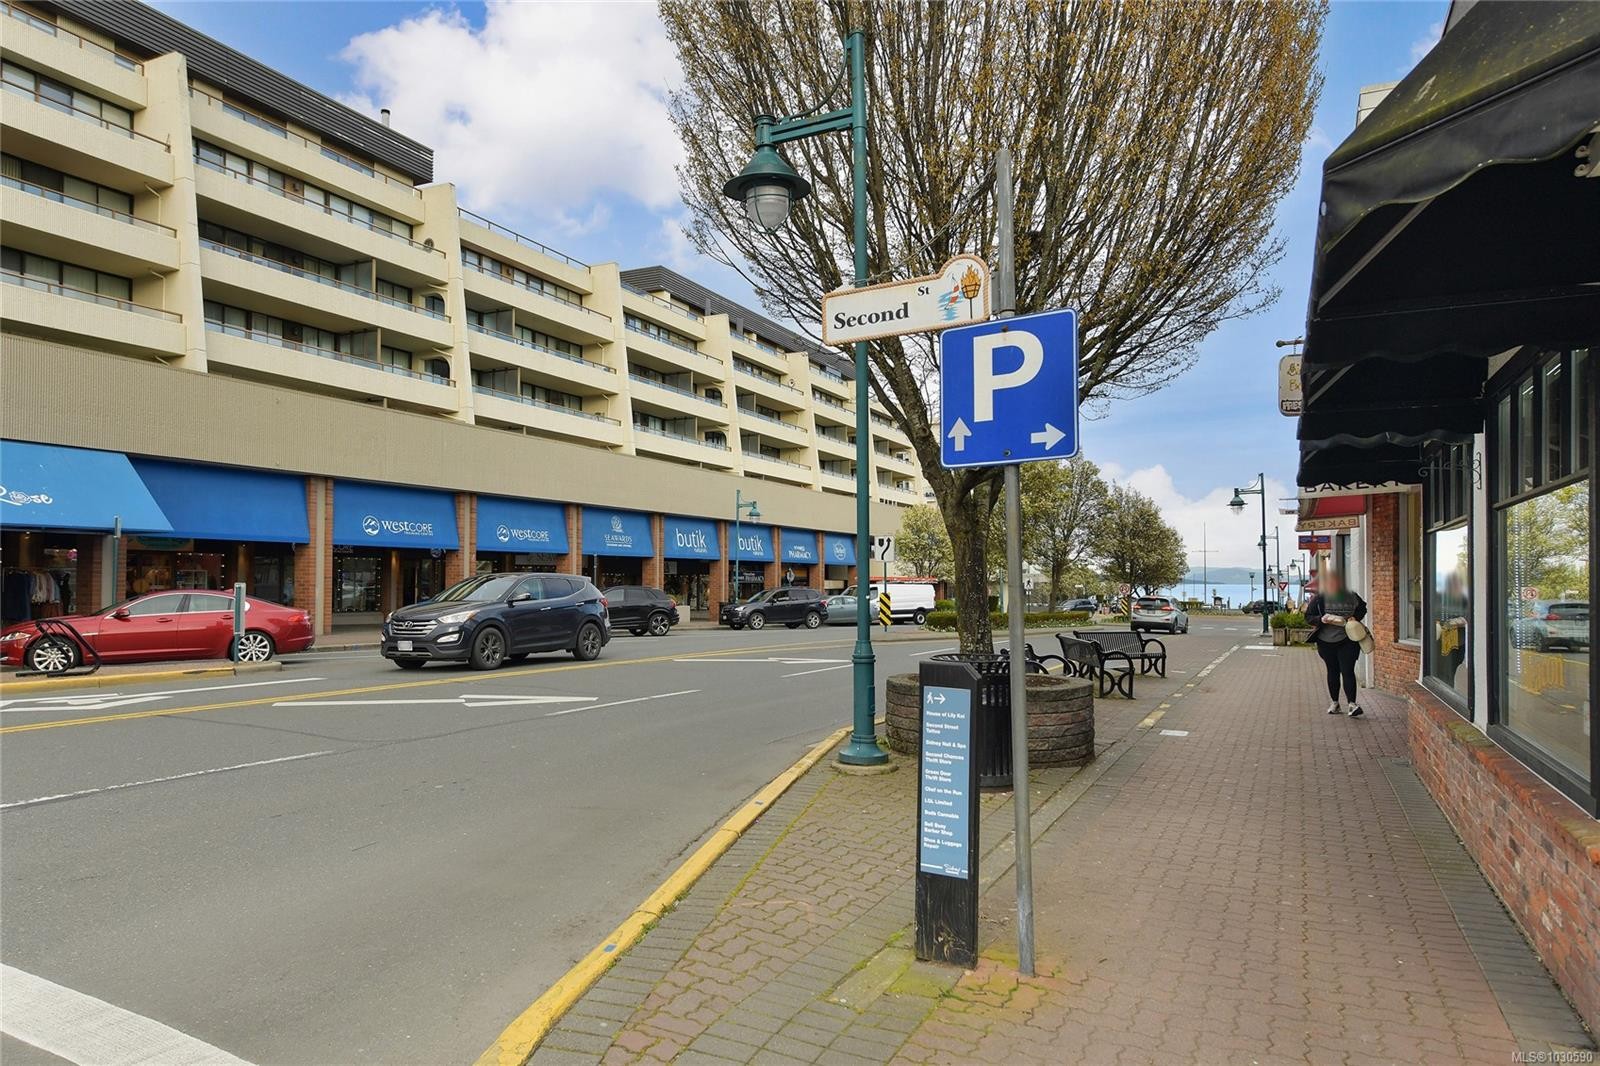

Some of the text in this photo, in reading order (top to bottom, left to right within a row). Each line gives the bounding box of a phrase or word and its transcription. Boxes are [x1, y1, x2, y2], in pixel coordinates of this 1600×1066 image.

[834, 286, 930, 330] Second St
[973, 330, 1044, 422] P
[676, 528, 706, 548] butik
[738, 535, 764, 552] butik
